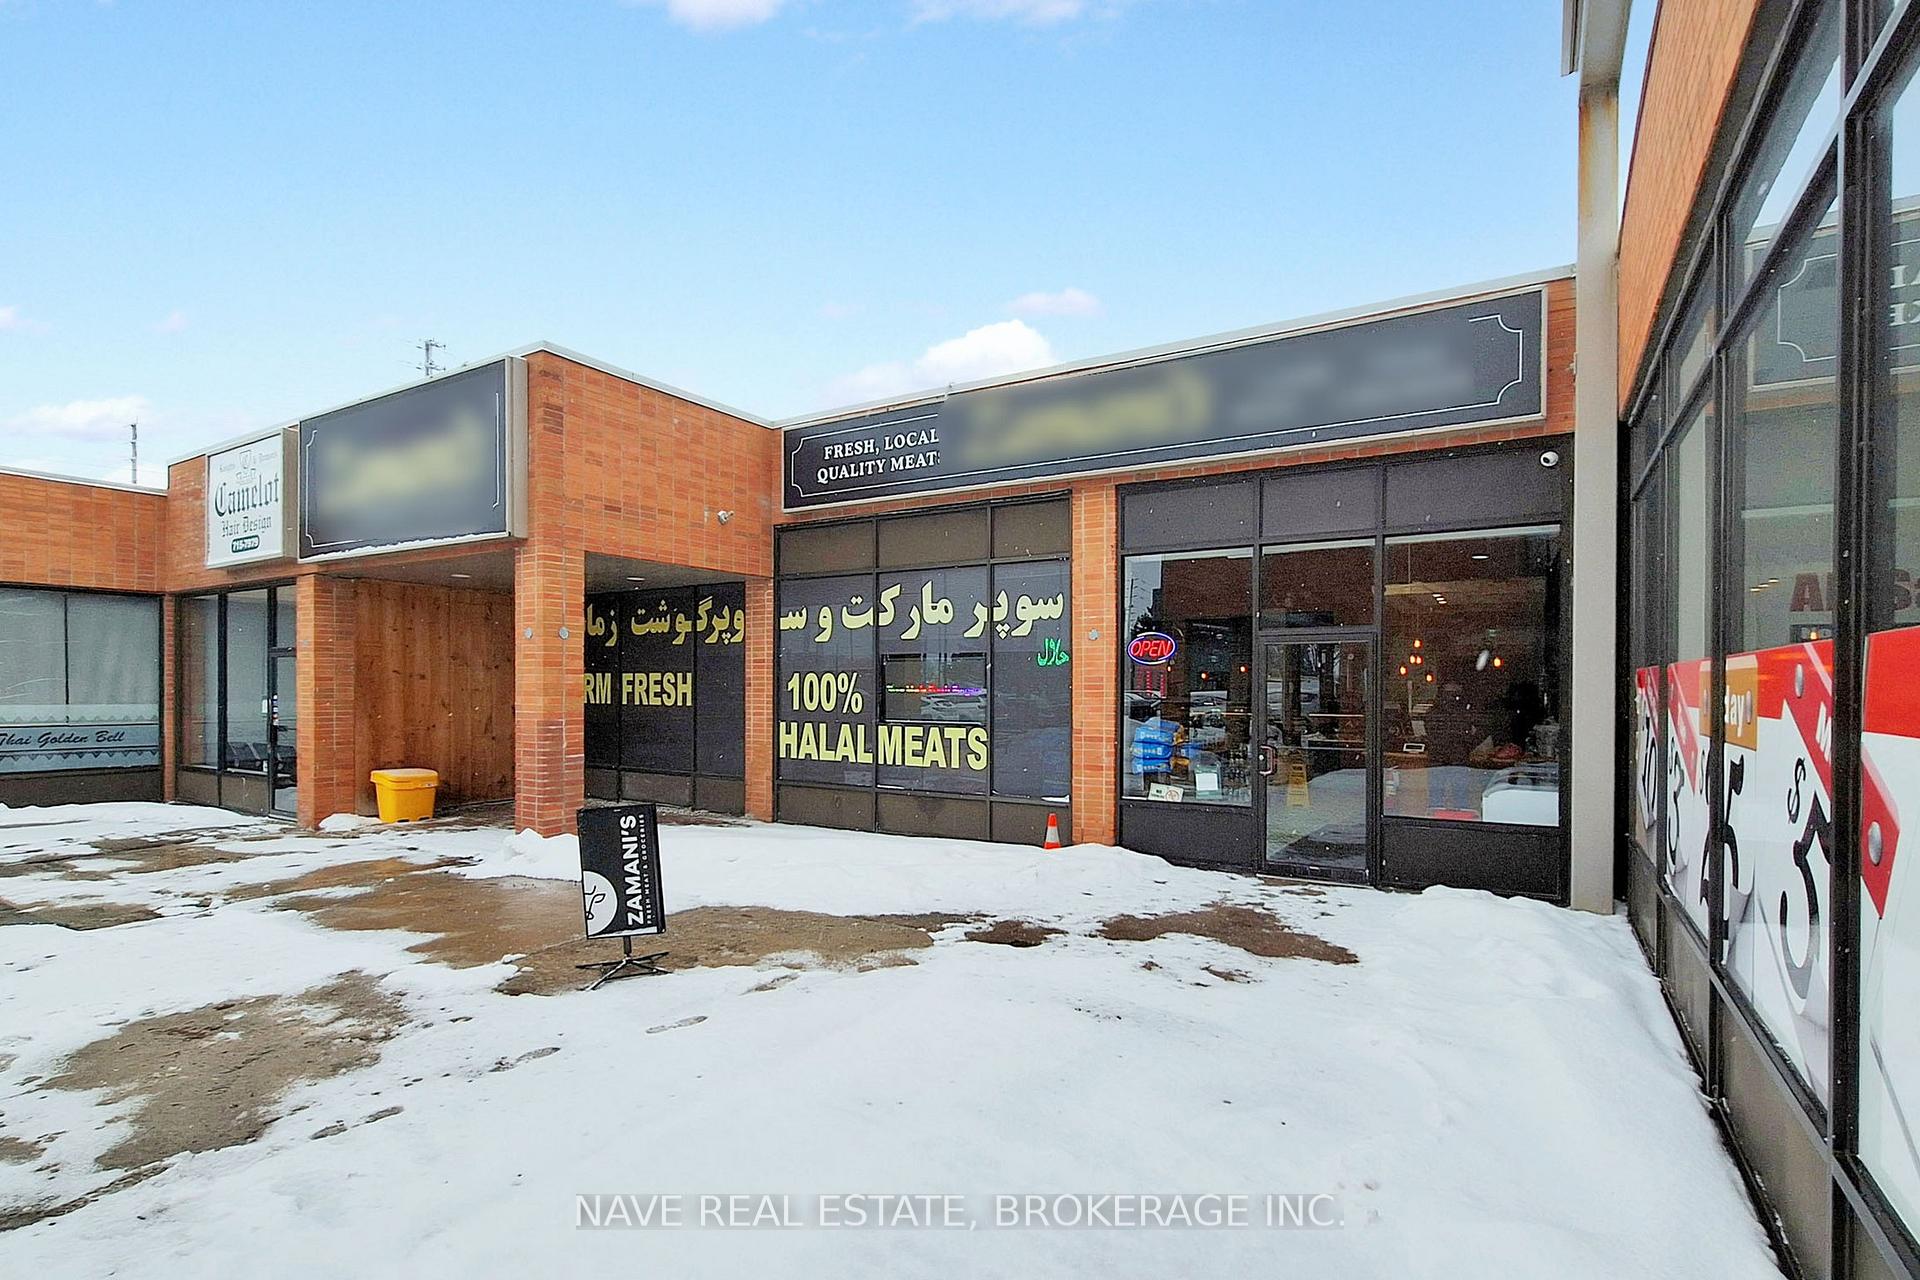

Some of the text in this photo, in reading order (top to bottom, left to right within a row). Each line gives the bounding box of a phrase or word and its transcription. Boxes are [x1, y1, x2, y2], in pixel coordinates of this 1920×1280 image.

[824, 428, 939, 460] FRESH, LOCAL
[817, 459, 886, 484] QUALITY
[214, 473, 279, 517] Camelot
[221, 516, 272, 538] Hair Design
[586, 603, 618, 647] زما
[841, 580, 954, 640] مارکت
[963, 590, 1064, 640] سوپر
[1130, 639, 1172, 658] OPEN
[584, 672, 693, 707] RM FRESH
[787, 672, 863, 714] 100%
[0, 730, 126, 748] Thai Golden Bell
[779, 721, 989, 770] HALAL MEATS
[638, 814, 648, 861] GROCERIES
[620, 814, 645, 926] ZAMANI'S
